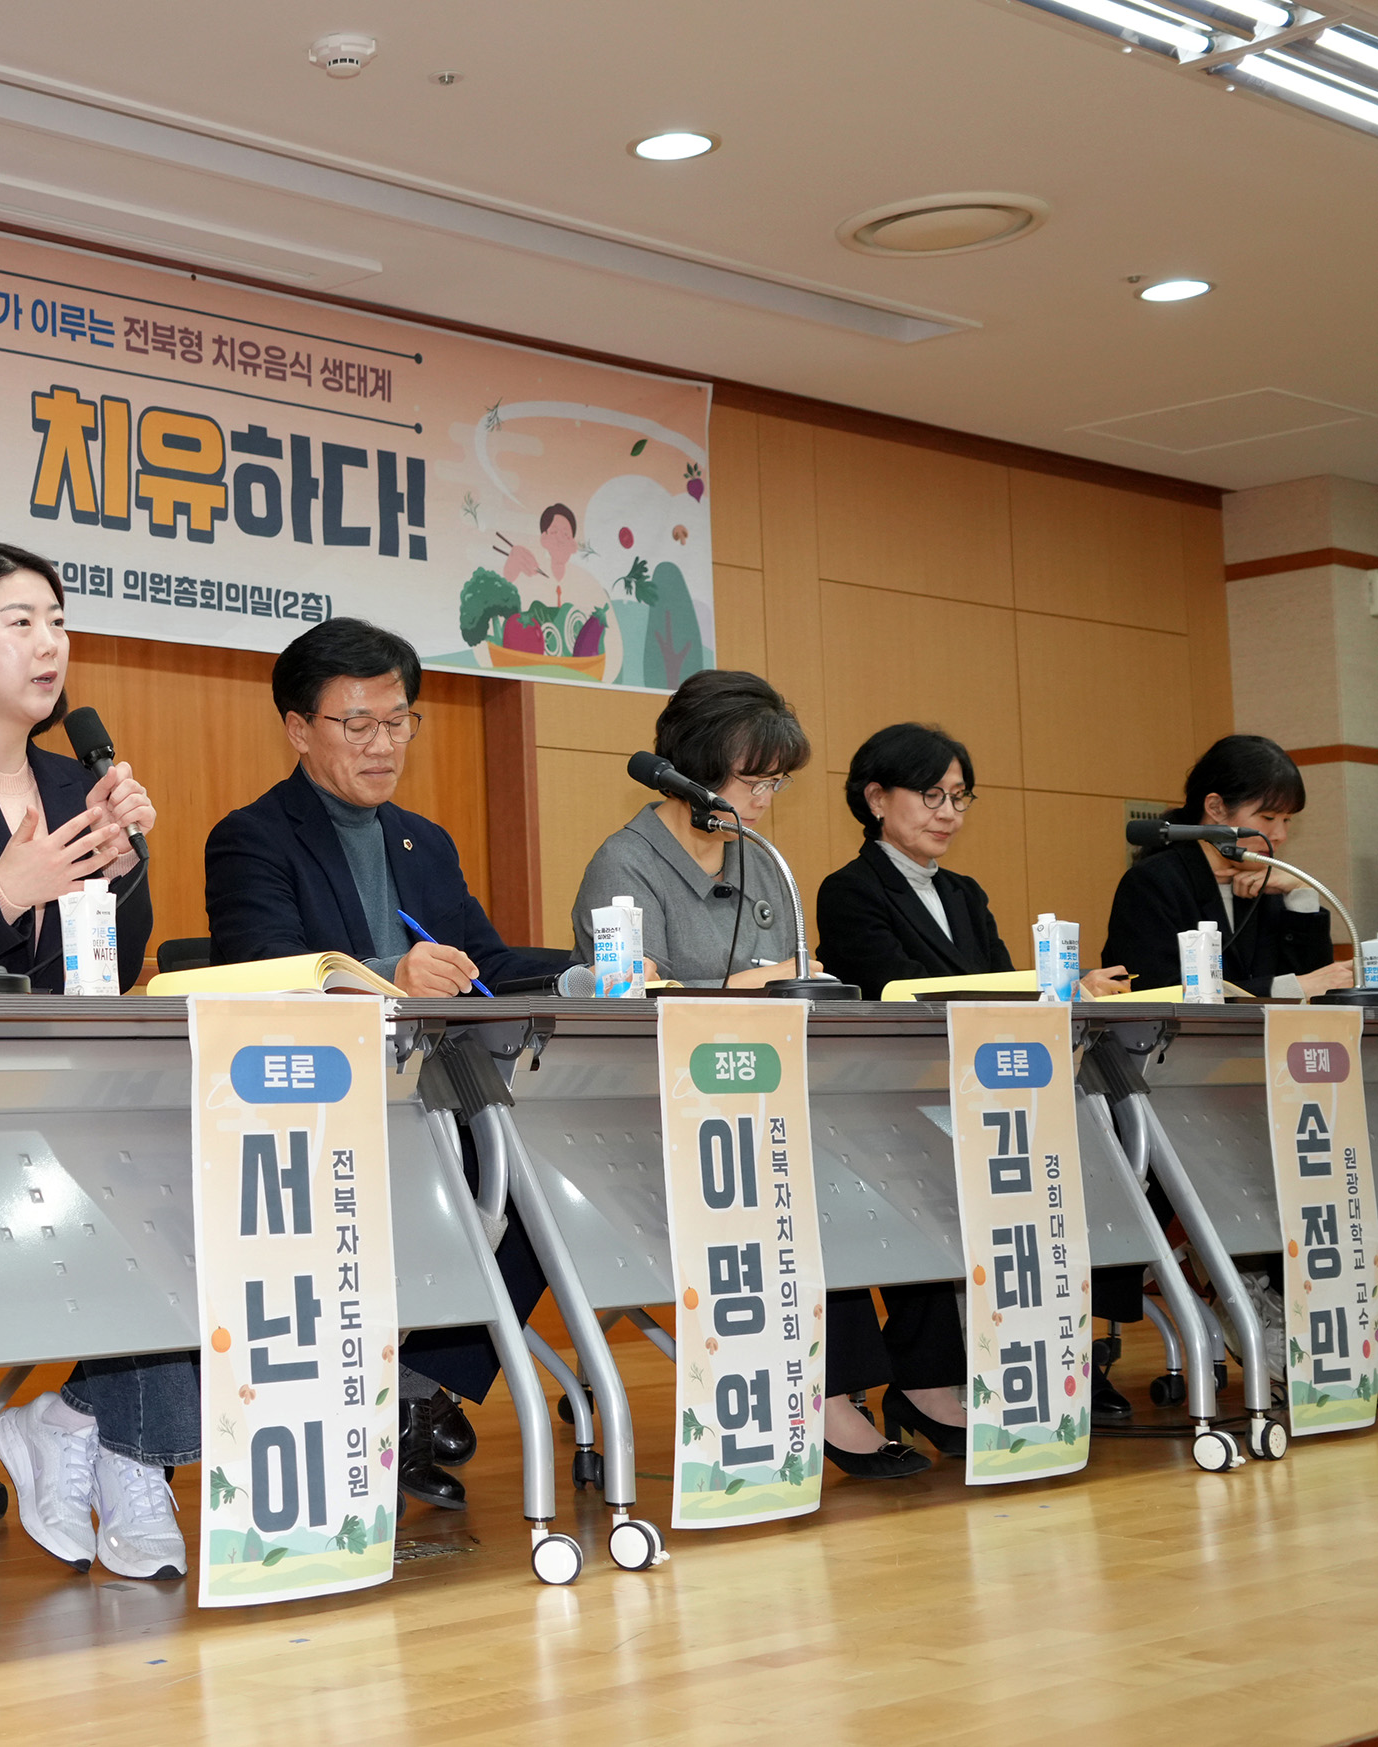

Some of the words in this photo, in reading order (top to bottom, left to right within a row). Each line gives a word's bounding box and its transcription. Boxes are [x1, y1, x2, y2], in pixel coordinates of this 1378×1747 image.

[31, 299, 115, 349] 이루는
[123, 315, 204, 366] 전북형
[212, 335, 313, 388] 치유음식
[321, 360, 392, 403] 생태계
[31, 384, 428, 562] 치유하다!
[122, 565, 333, 623] 의원총회의실(2층)
[264, 1054, 315, 1088] 토론
[715, 1051, 756, 1081] 좌장
[996, 1050, 1029, 1077] 토론
[1303, 1048, 1331, 1073] 발제
[332, 1150, 366, 1406] 전북자치도의회
[699, 1117, 774, 1467] 이명연
[769, 1117, 800, 1341] 전북자치도의회
[786, 1359, 806, 1454] 부의장
[982, 1110, 1051, 1426] 김태희
[1044, 1155, 1071, 1298] 경희대학교
[1058, 1315, 1075, 1370] 교수
[1296, 1103, 1352, 1385] 손정민
[1355, 1282, 1369, 1330] 교수
[240, 1131, 328, 1533] 서난이
[346, 1427, 369, 1498] 의원
